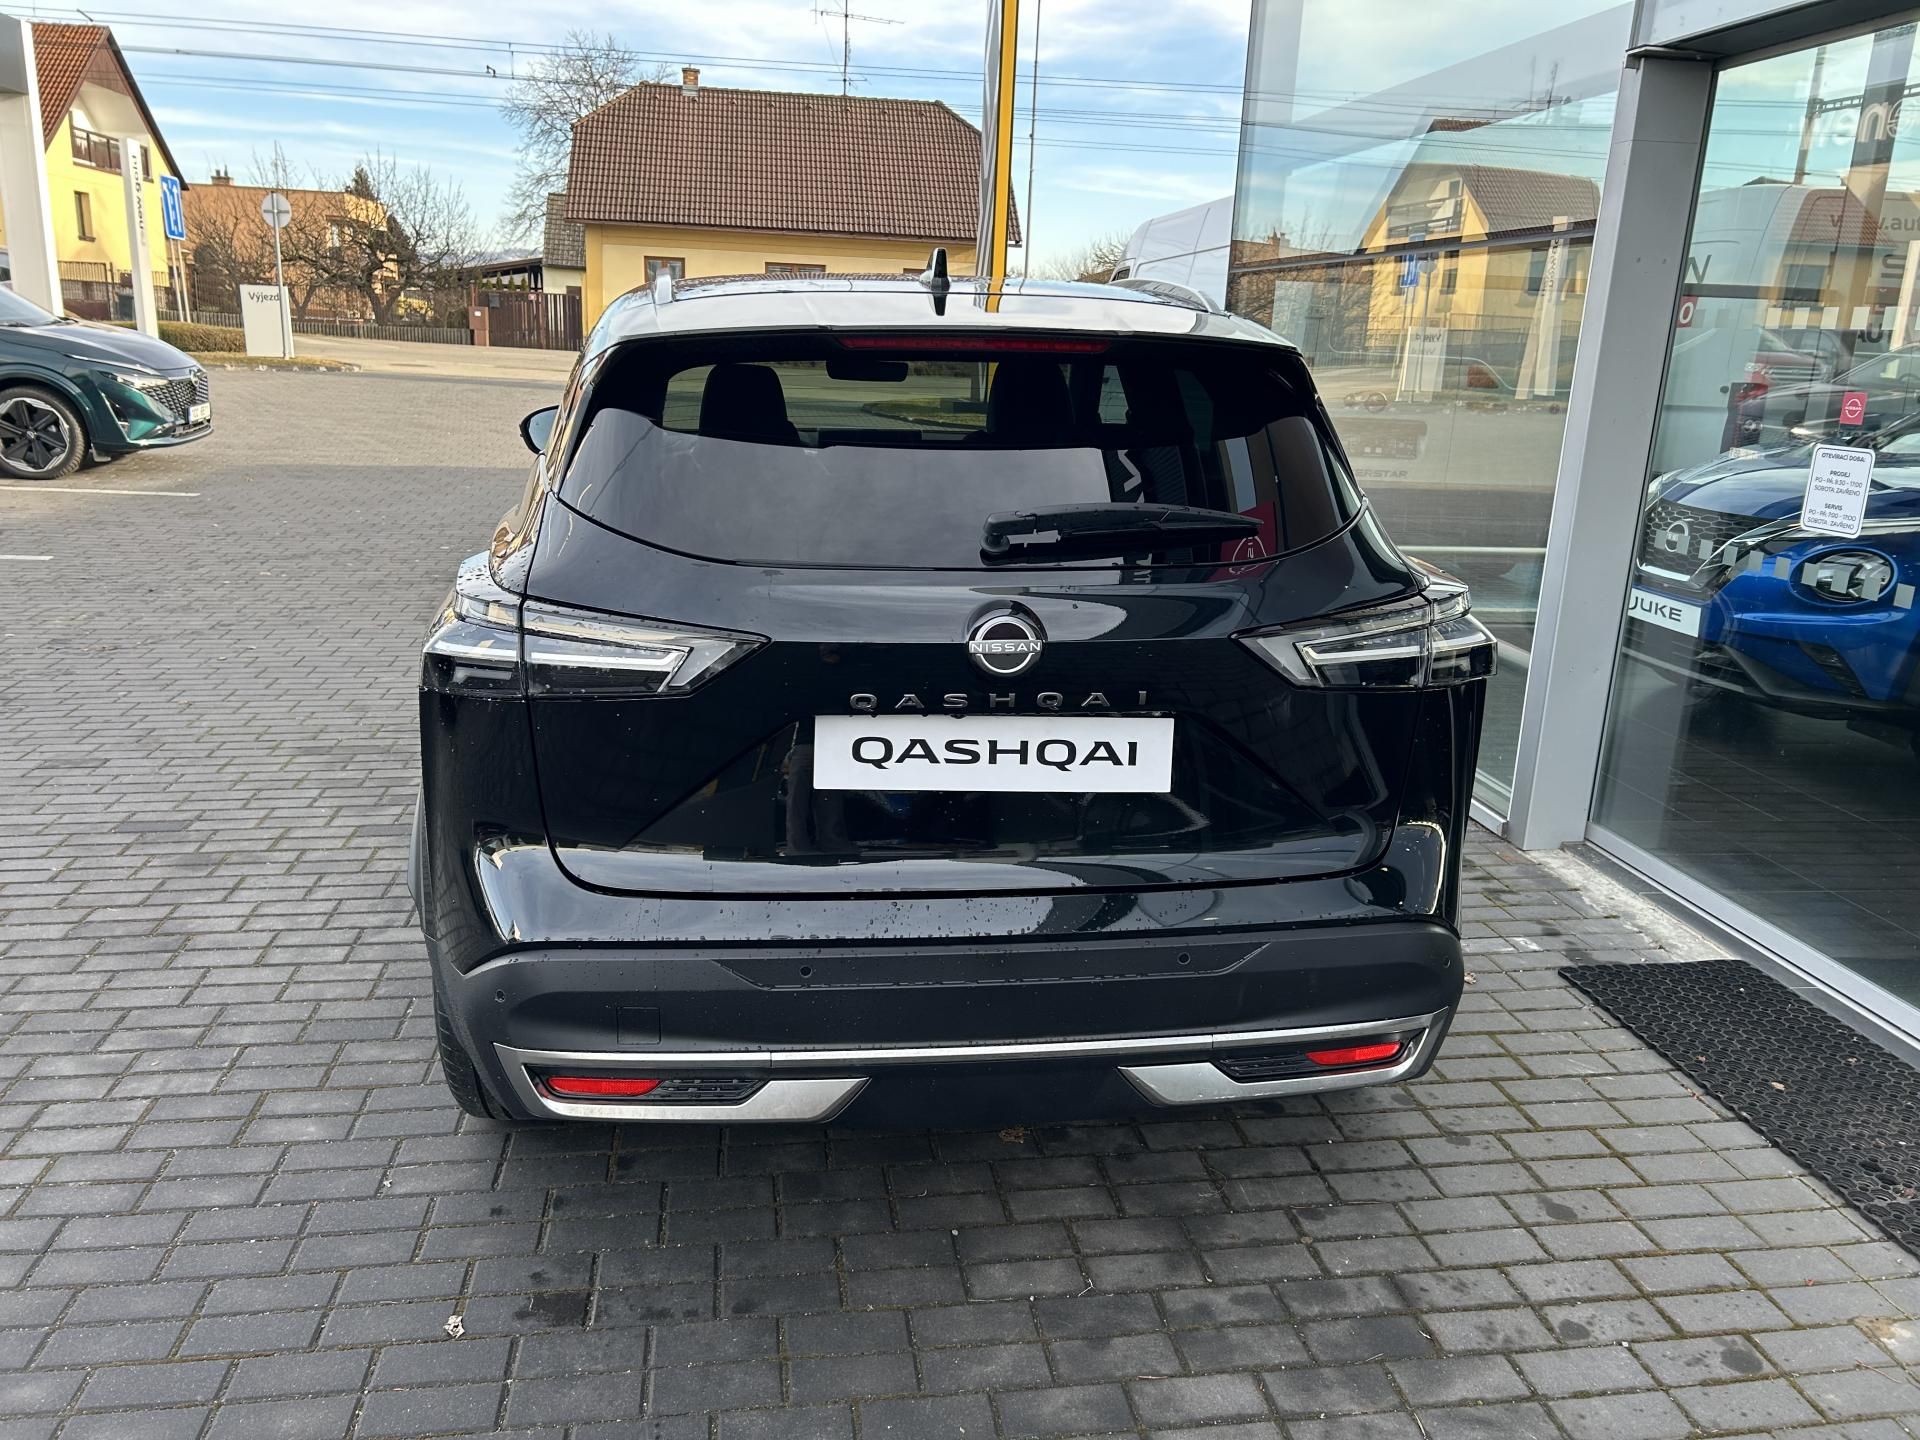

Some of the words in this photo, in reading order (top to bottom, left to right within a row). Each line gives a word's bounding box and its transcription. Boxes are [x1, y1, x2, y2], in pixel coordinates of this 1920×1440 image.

[248, 291, 281, 303] Výjezd
[1829, 470, 1851, 478] PRODEJ
[1628, 596, 1683, 623] JUKE
[970, 641, 1042, 653] NISSAN
[849, 690, 1148, 712] QASHQAI
[851, 736, 1138, 772] QASHQAI
